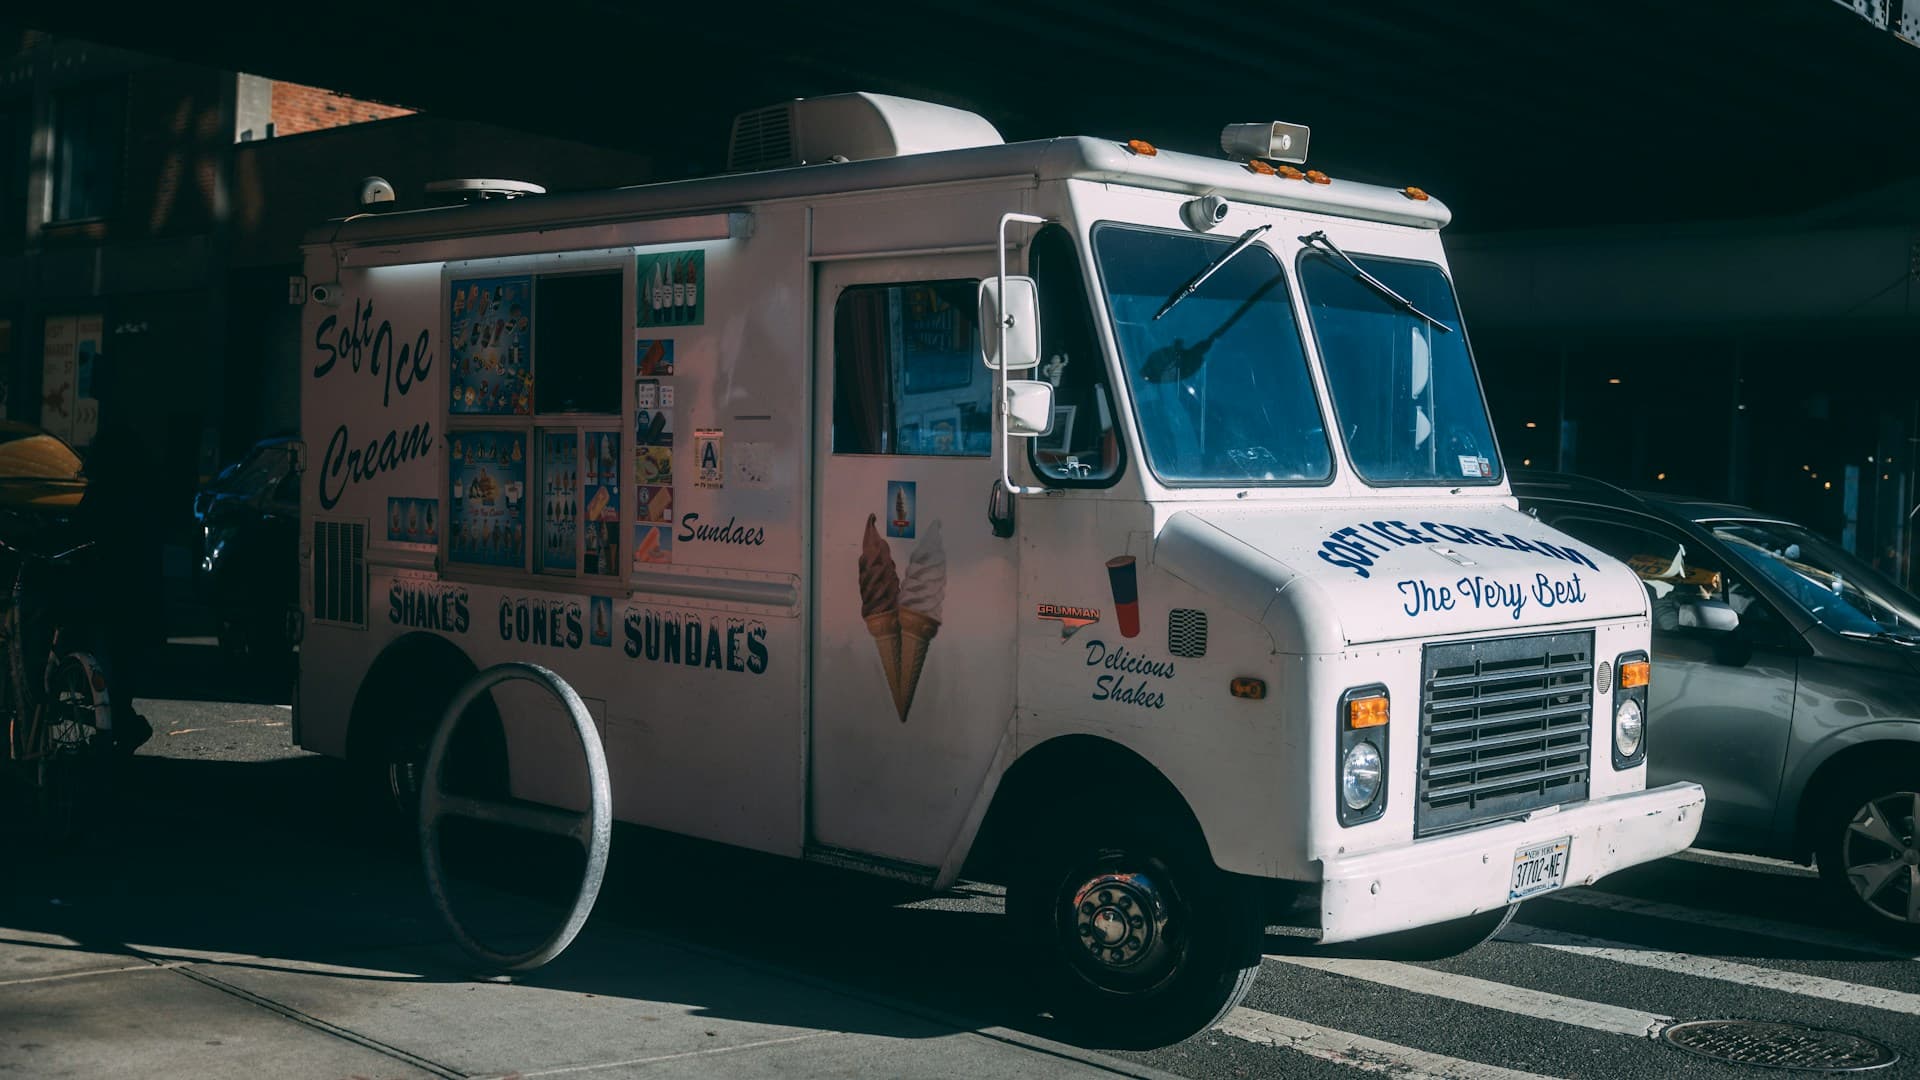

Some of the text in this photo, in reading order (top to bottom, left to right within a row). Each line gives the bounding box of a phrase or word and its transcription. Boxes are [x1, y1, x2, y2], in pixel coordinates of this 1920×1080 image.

[313, 298, 433, 407] Soft Ice
[319, 421, 433, 510] Cream
[701, 441, 717, 469] A
[677, 512, 766, 546] Sundaes
[1317, 520, 1600, 579] SOFT ICE CREAM
[388, 579, 470, 633] SHAKES
[1037, 603, 1100, 619] GRUMMAN
[1397, 572, 1587, 620] The Very Best
[499, 595, 584, 649] CONES
[623, 606, 769, 674] SUNDAES
[1086, 639, 1176, 679] Delicious
[1092, 675, 1166, 709] Shakes
